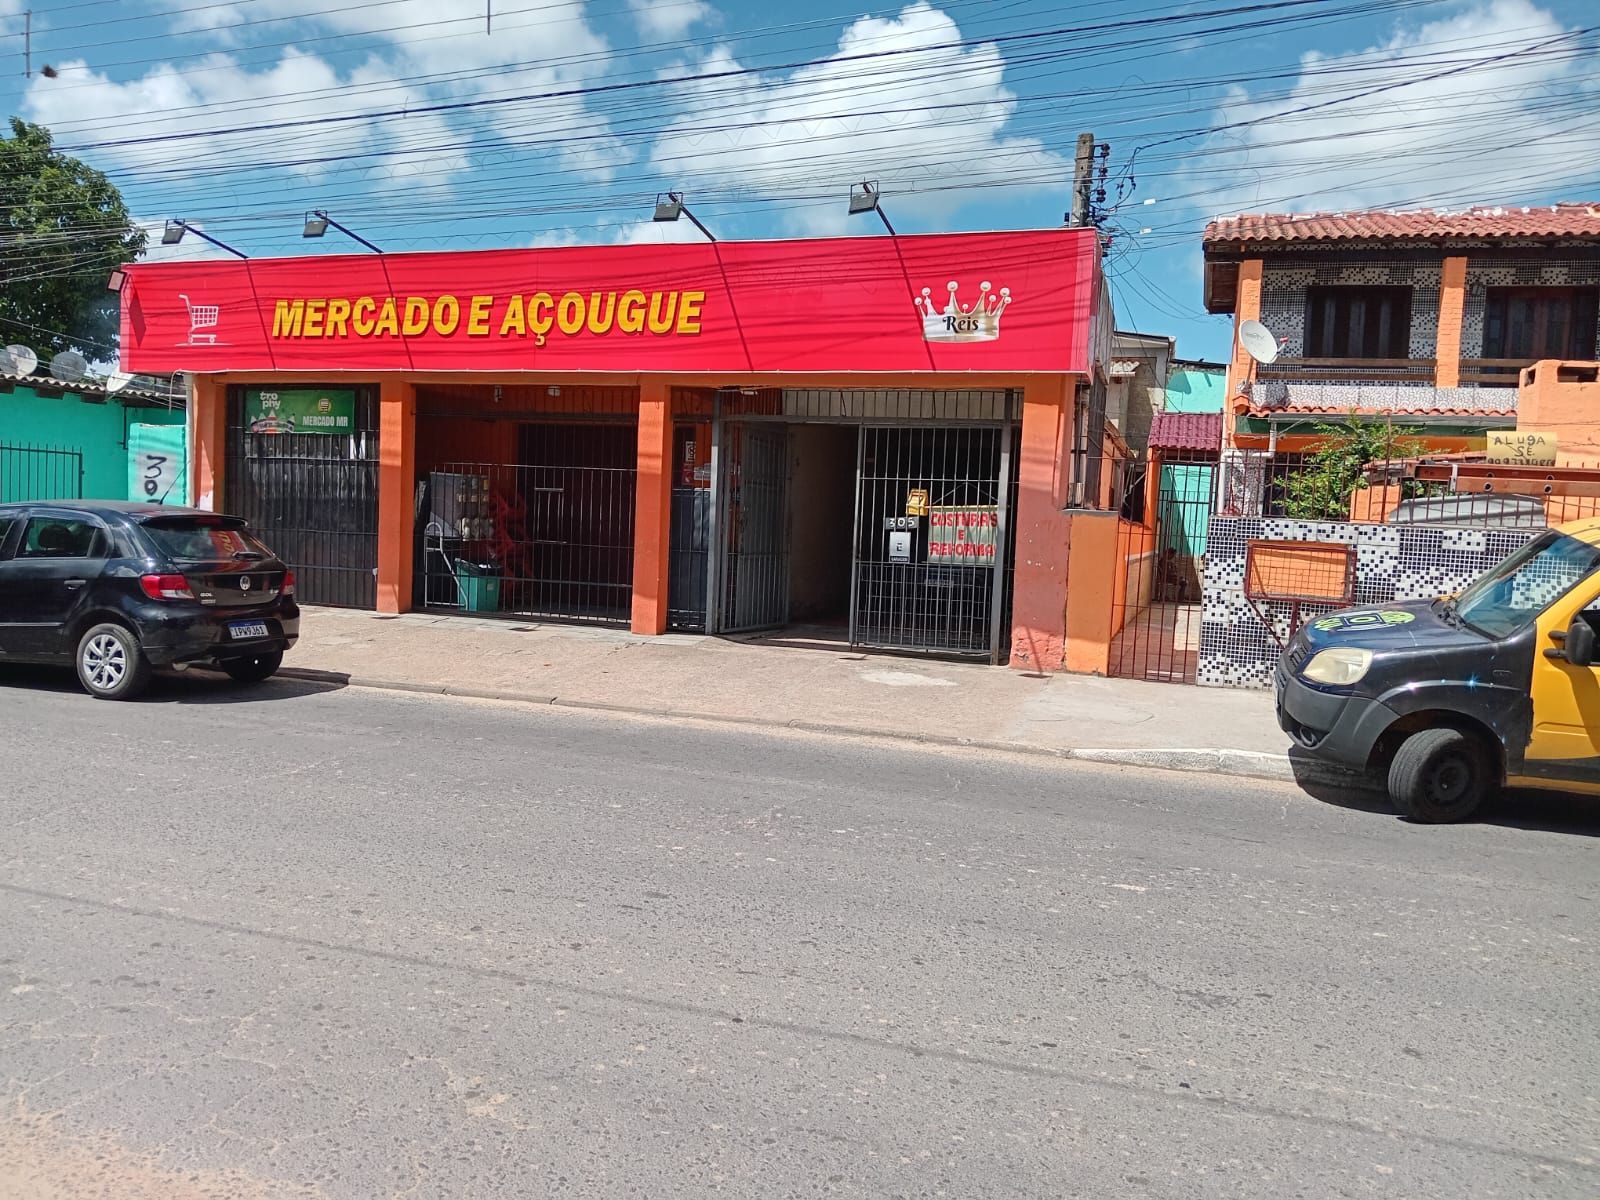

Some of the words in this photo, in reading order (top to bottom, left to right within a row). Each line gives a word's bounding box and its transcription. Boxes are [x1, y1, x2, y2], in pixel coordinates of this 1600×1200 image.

[272, 294, 460, 338] MERCADO
[467, 295, 494, 336] E
[500, 289, 706, 347] AÇOUGUE
[942, 315, 979, 334] Reis
[302, 415, 335, 427] MERCADO
[336, 416, 348, 427] MR
[144, 454, 167, 503] 30
[889, 517, 915, 527] 305
[958, 529, 965, 540] E
